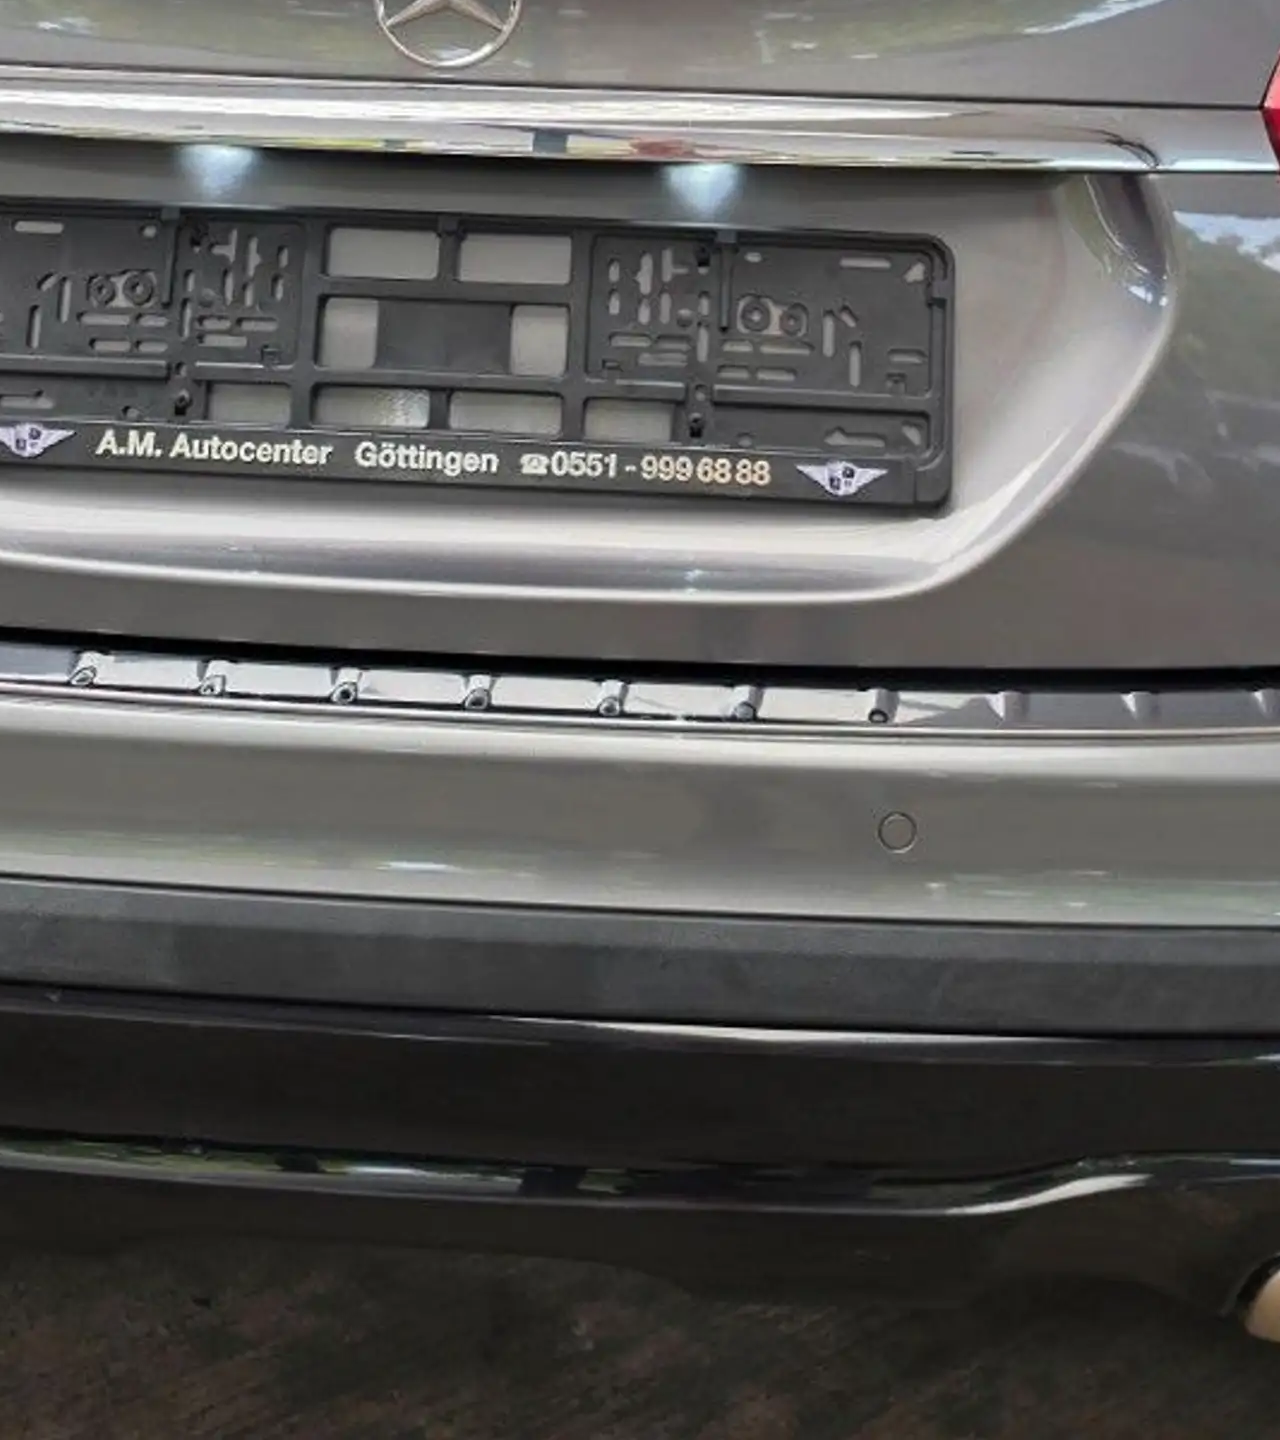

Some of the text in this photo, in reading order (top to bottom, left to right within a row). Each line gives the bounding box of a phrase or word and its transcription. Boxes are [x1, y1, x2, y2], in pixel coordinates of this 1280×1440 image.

[95, 429, 162, 459] A.M.
[168, 431, 334, 465] Autocenter
[353, 440, 500, 477] Göttingen
